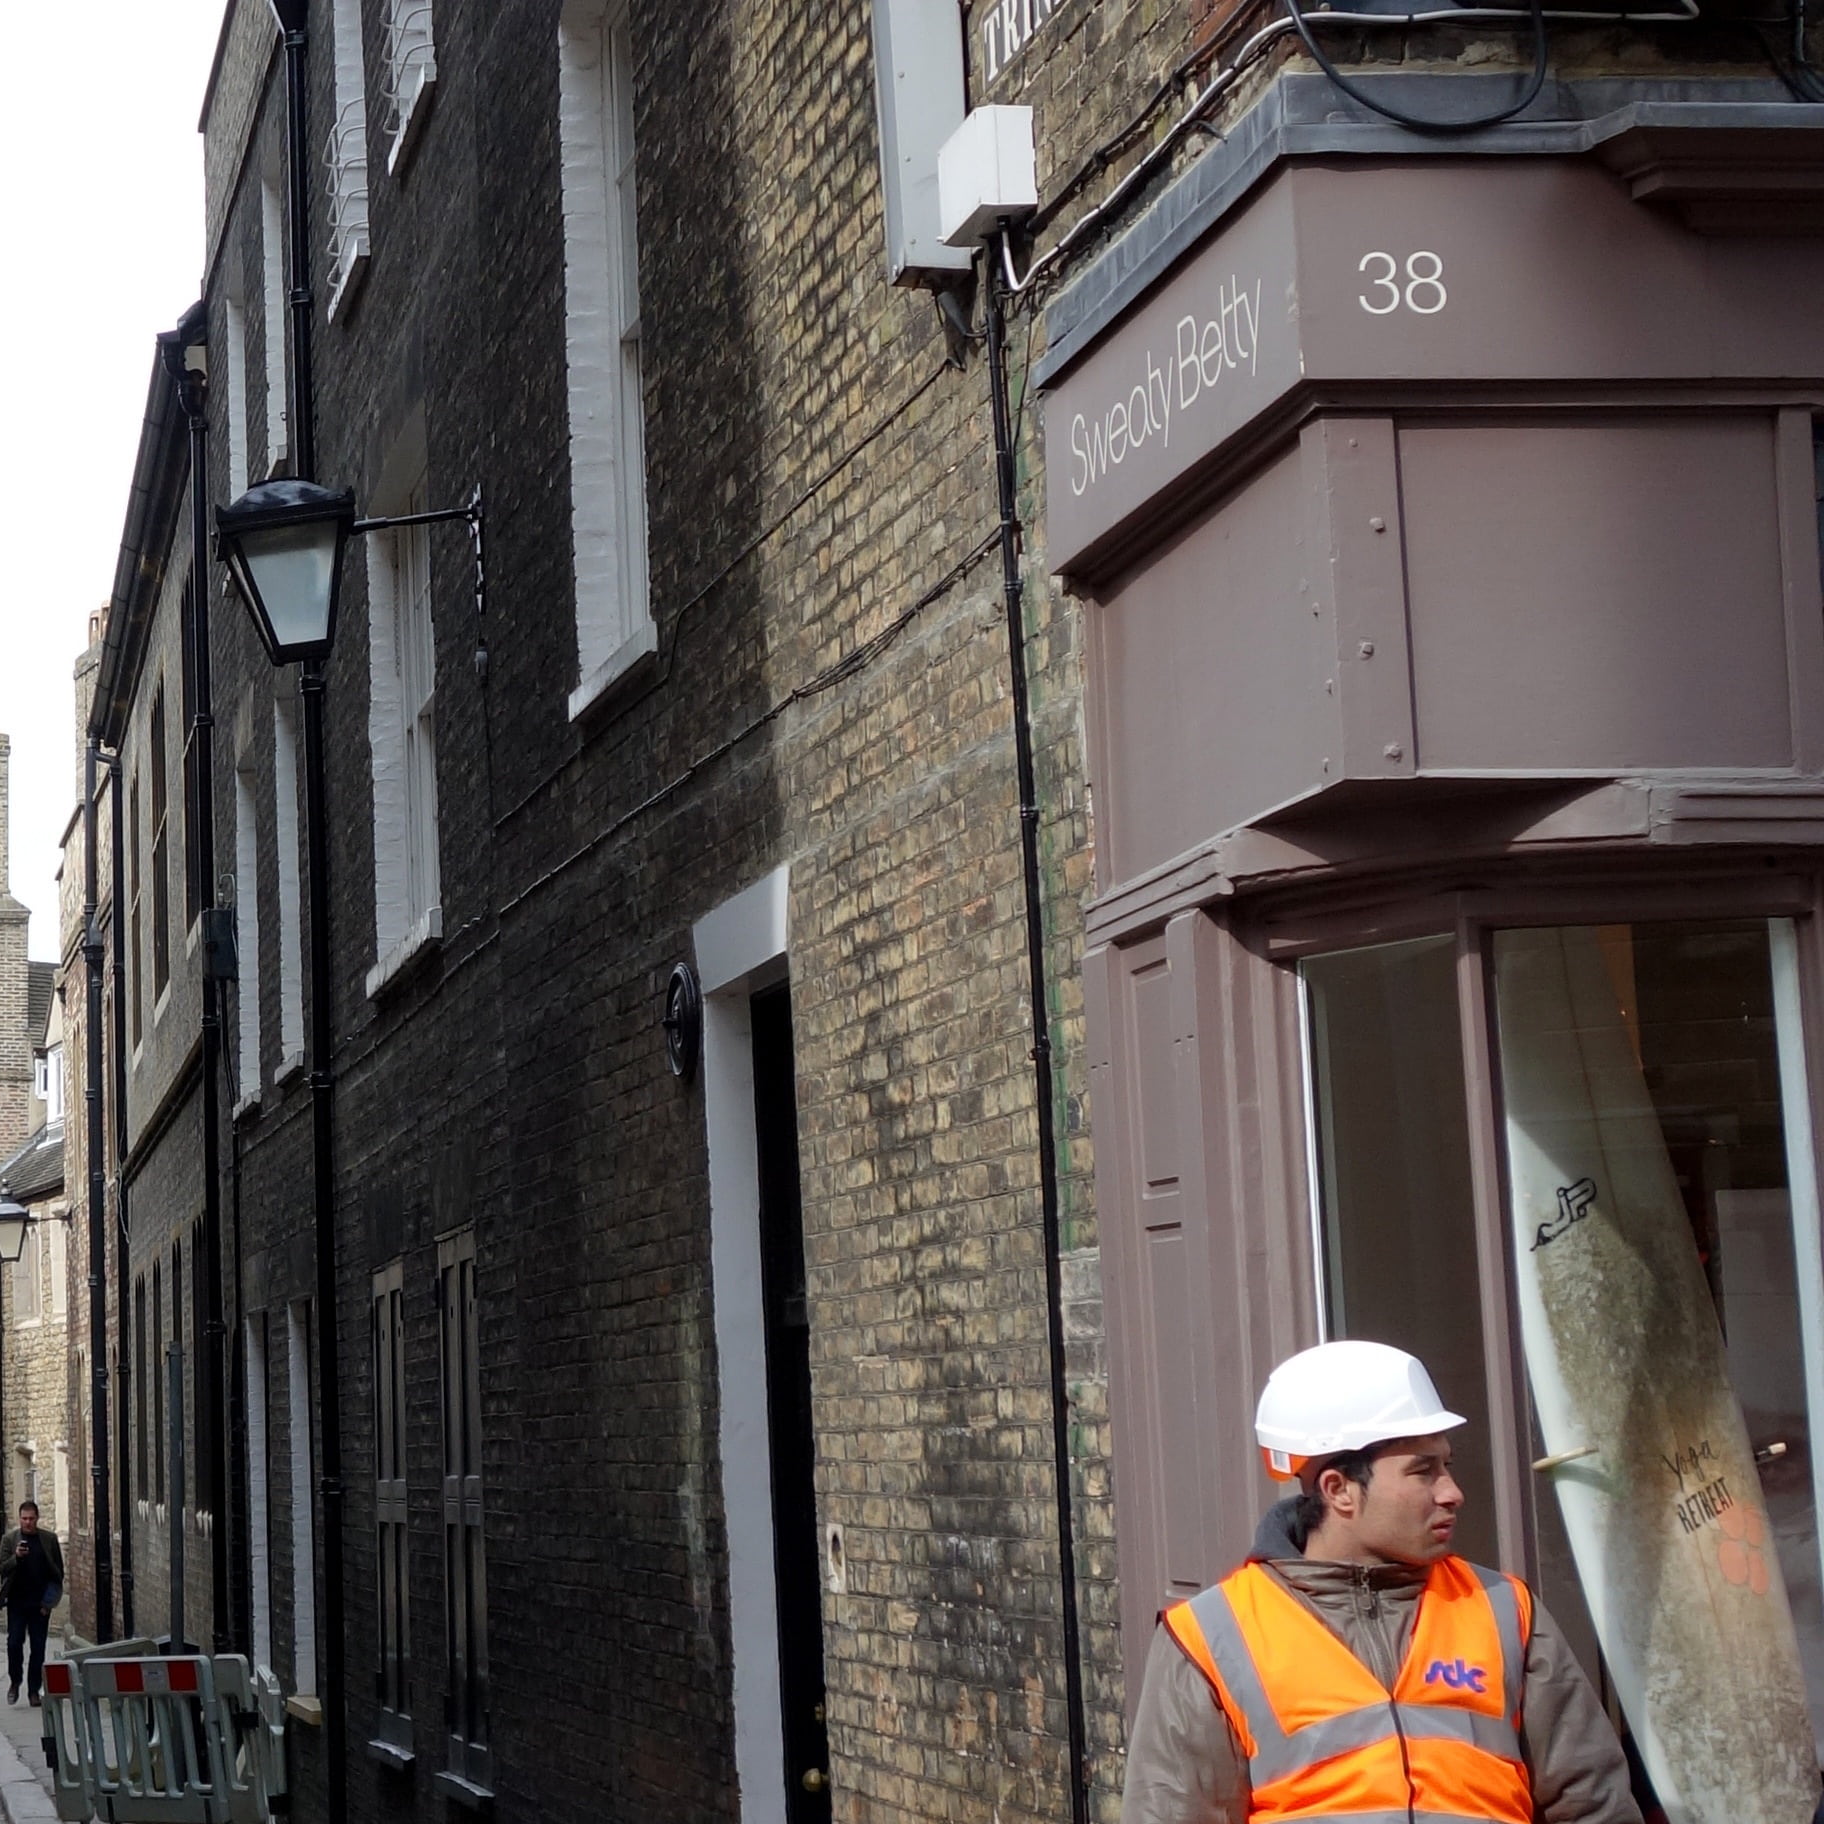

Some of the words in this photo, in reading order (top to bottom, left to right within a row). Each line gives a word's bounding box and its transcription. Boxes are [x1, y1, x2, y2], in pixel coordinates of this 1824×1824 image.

[1358, 250, 1448, 315] 38
[1071, 349, 1174, 497] Sweaty
[1176, 274, 1261, 411] Betty
[1660, 1439, 1721, 1493] Yoga
[1677, 1476, 1735, 1535] RETREAT
